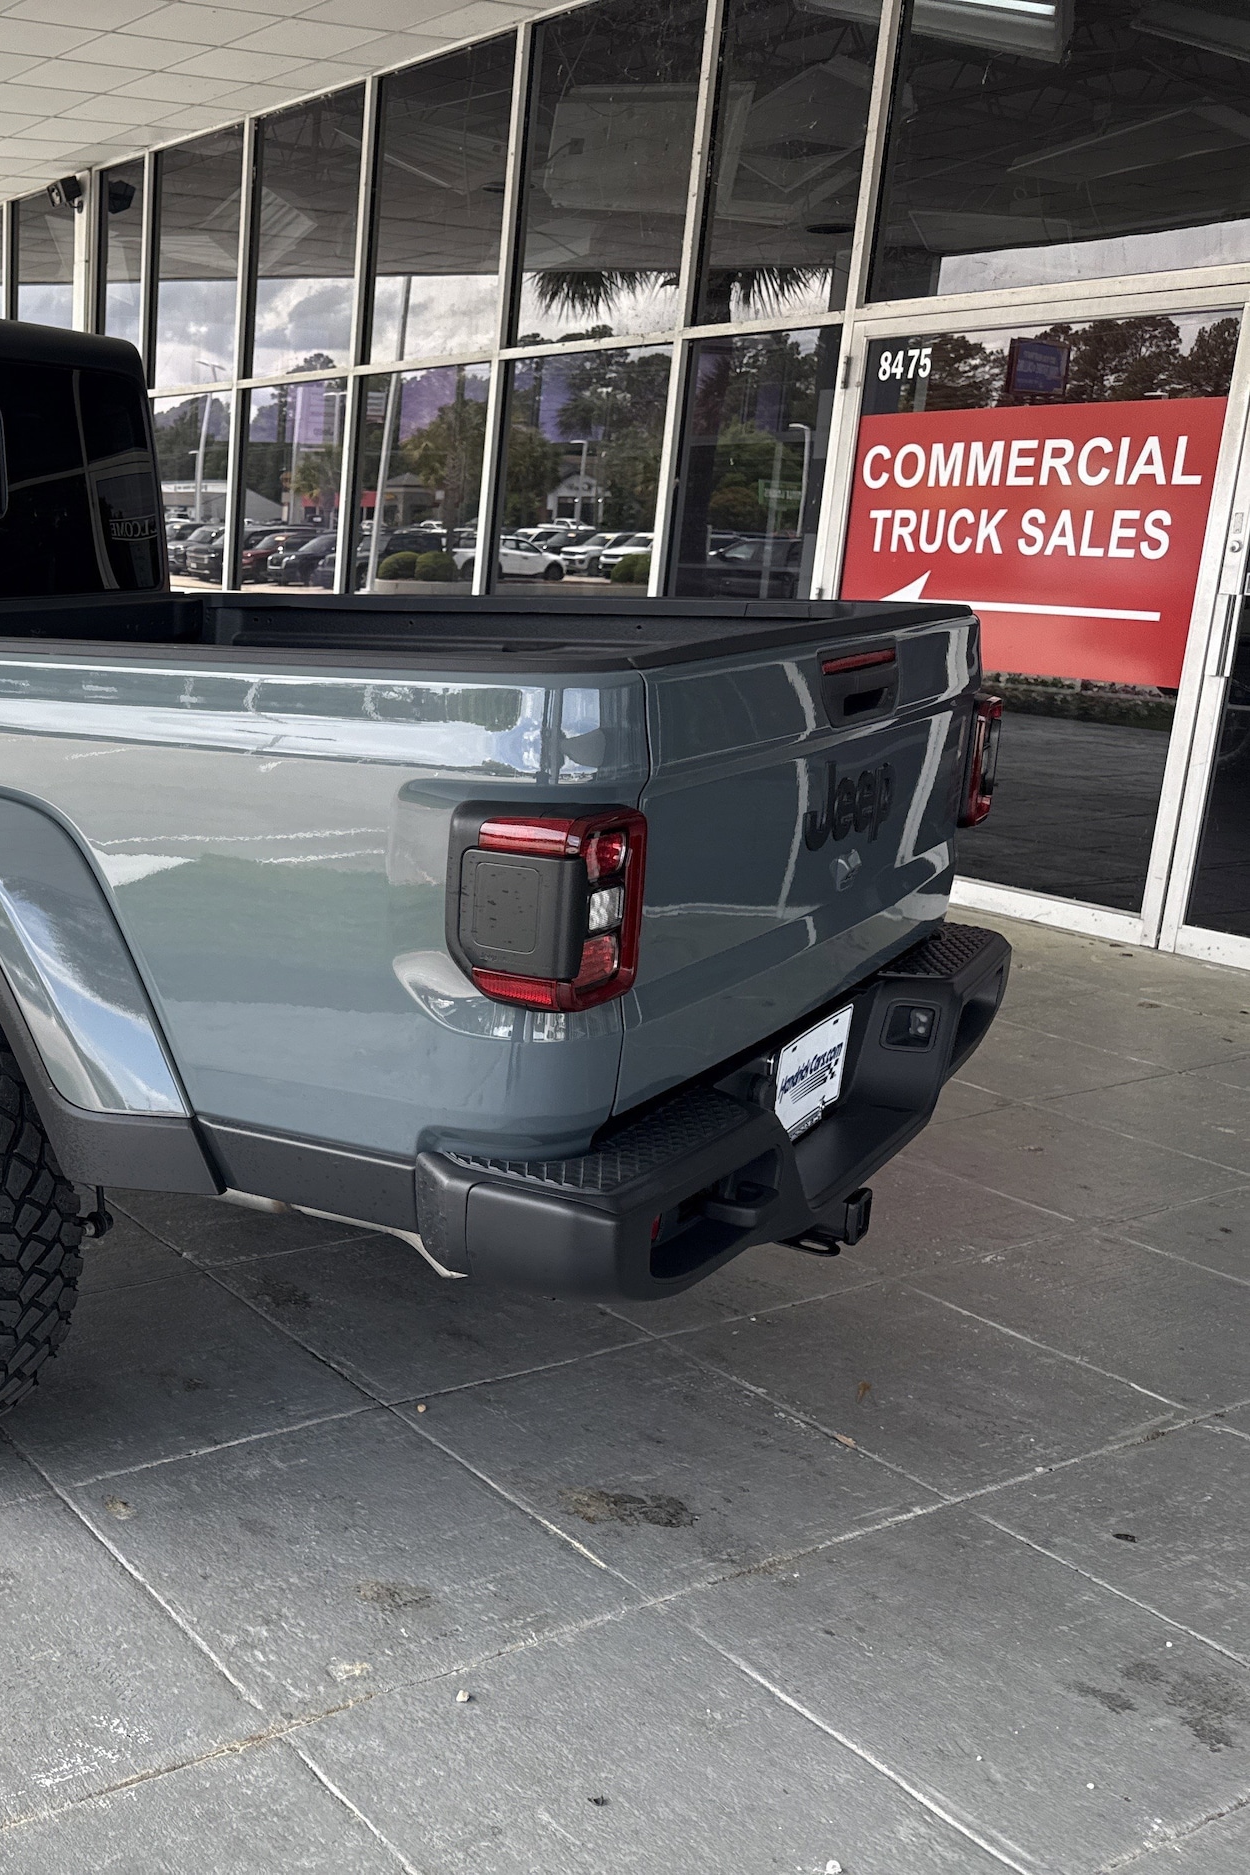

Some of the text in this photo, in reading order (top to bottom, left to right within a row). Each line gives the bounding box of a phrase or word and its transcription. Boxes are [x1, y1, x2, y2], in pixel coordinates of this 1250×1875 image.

[877, 347, 932, 381] 8475
[862, 435, 1203, 490] COMMERCIAL
[869, 507, 1172, 560] TRUCK SALES
[803, 761, 895, 851] Jeep
